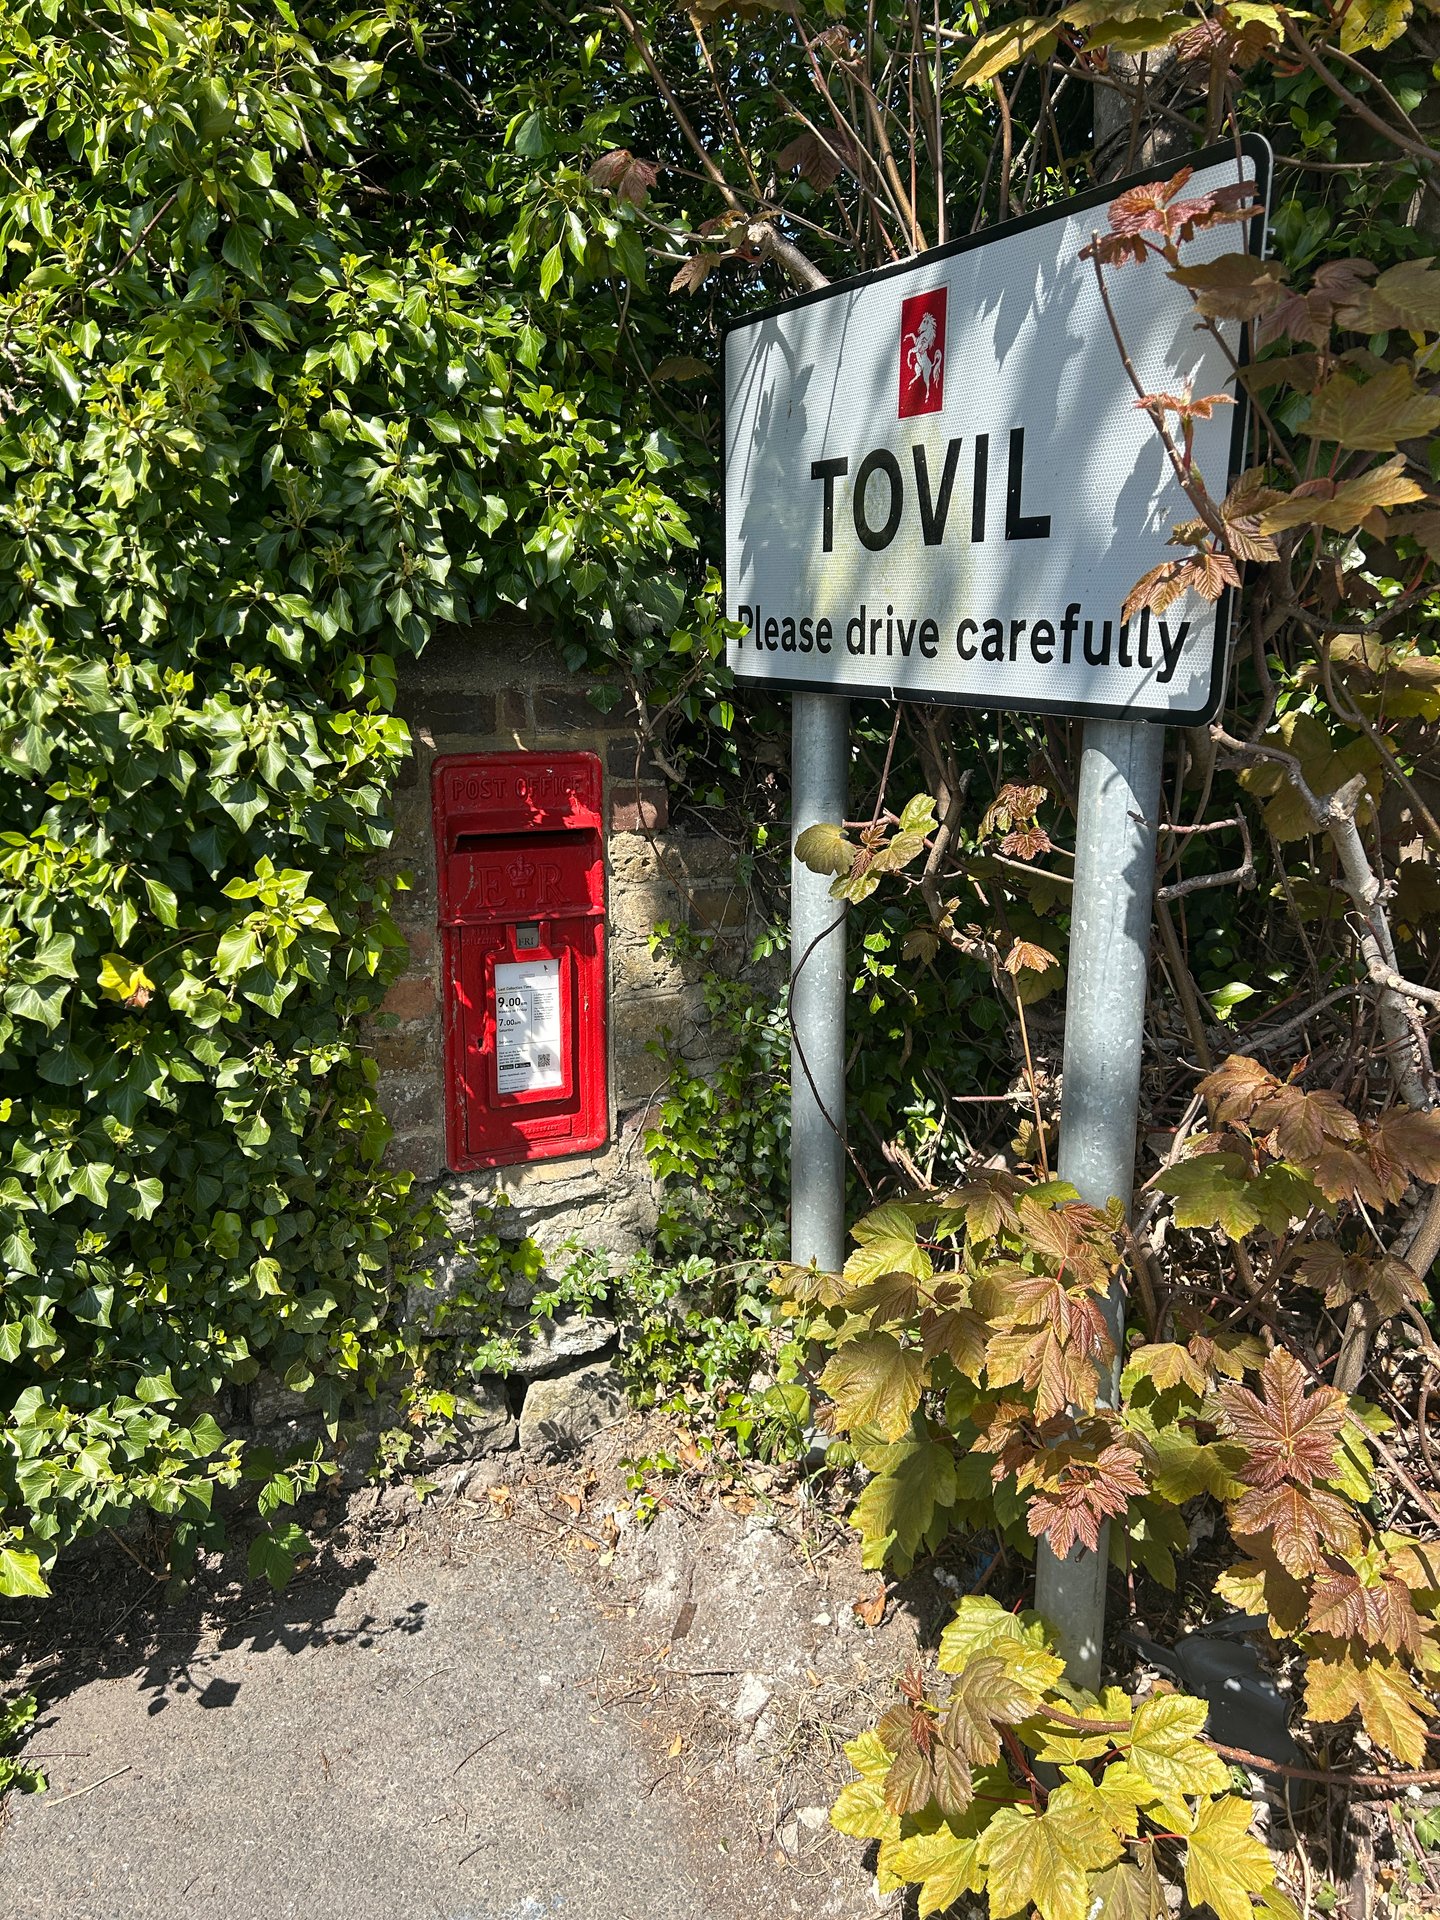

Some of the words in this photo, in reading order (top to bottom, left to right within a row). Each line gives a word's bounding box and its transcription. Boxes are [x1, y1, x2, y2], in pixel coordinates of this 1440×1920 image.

[811, 427, 1052, 552] TOVIL
[738, 604, 832, 654] Please
[846, 604, 940, 659] drive
[956, 602, 1191, 684] carefully
[453, 778, 507, 801] POST
[515, 775, 583, 797] OFFICE
[476, 866, 507, 909] E
[537, 863, 572, 905] R
[518, 937, 534, 946] FRI
